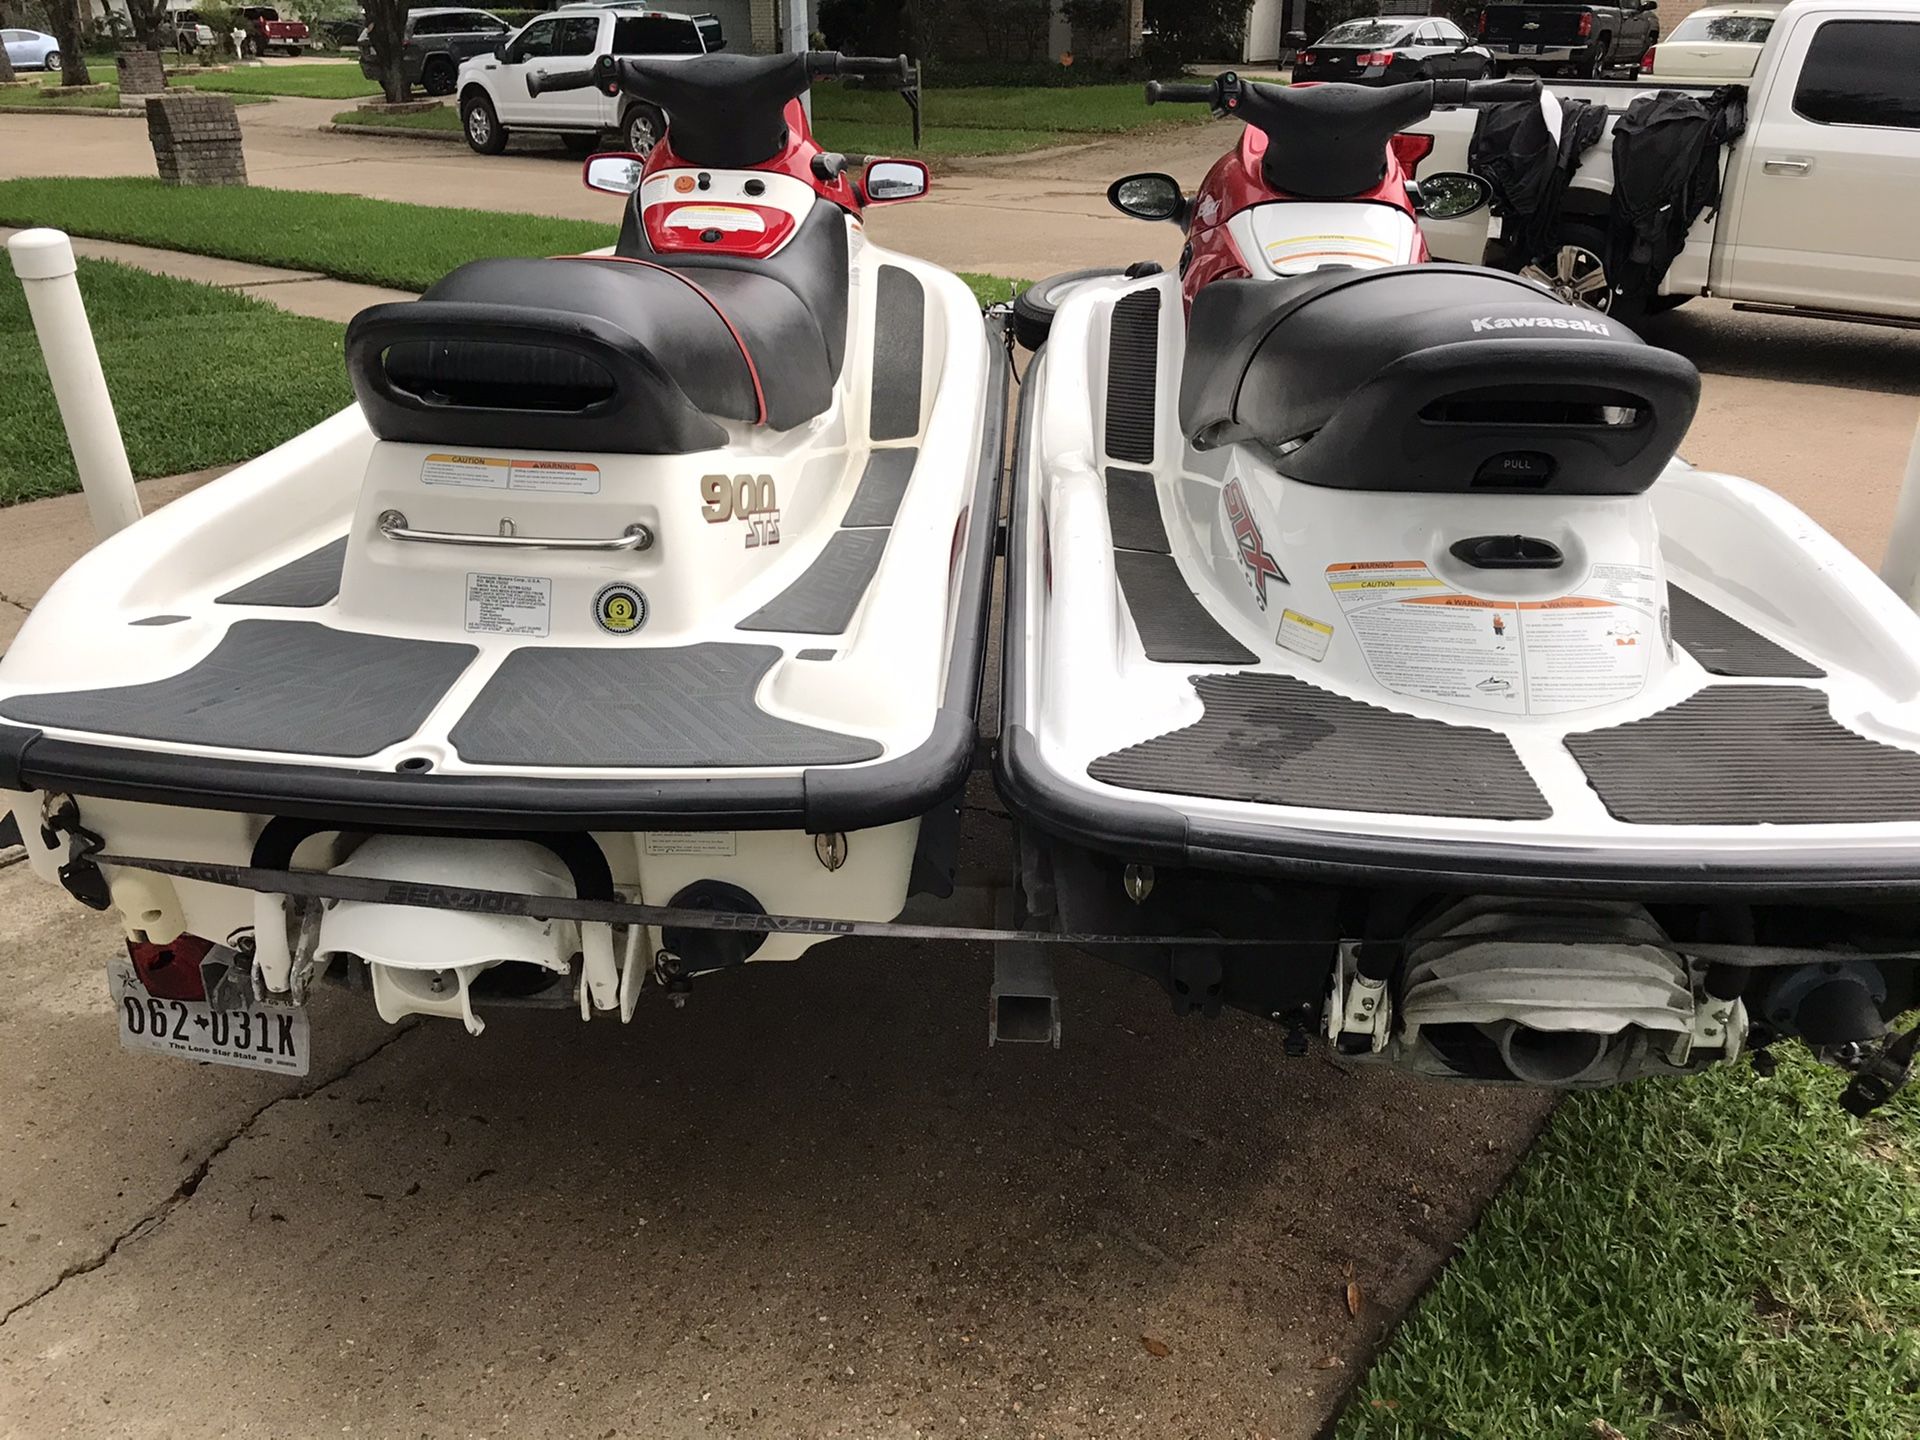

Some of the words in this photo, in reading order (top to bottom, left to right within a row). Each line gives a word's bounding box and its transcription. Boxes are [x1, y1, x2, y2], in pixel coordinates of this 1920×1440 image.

[1471, 316, 1611, 337] Kawasaki
[451, 455, 486, 465] CAUTION
[1503, 459, 1532, 470] PULL
[539, 462, 577, 471] WARNING
[700, 473, 777, 525] 900
[1222, 476, 1292, 608] STX
[1357, 561, 1395, 569] WARNING
[1360, 581, 1396, 589] CAUTION
[615, 603, 625, 616] 3
[1454, 599, 1495, 609] WARNING
[168, 1041, 187, 1051] The
[188, 1043, 211, 1054] Lone
[212, 1047, 232, 1058] Star
[232, 1051, 258, 1061] State
